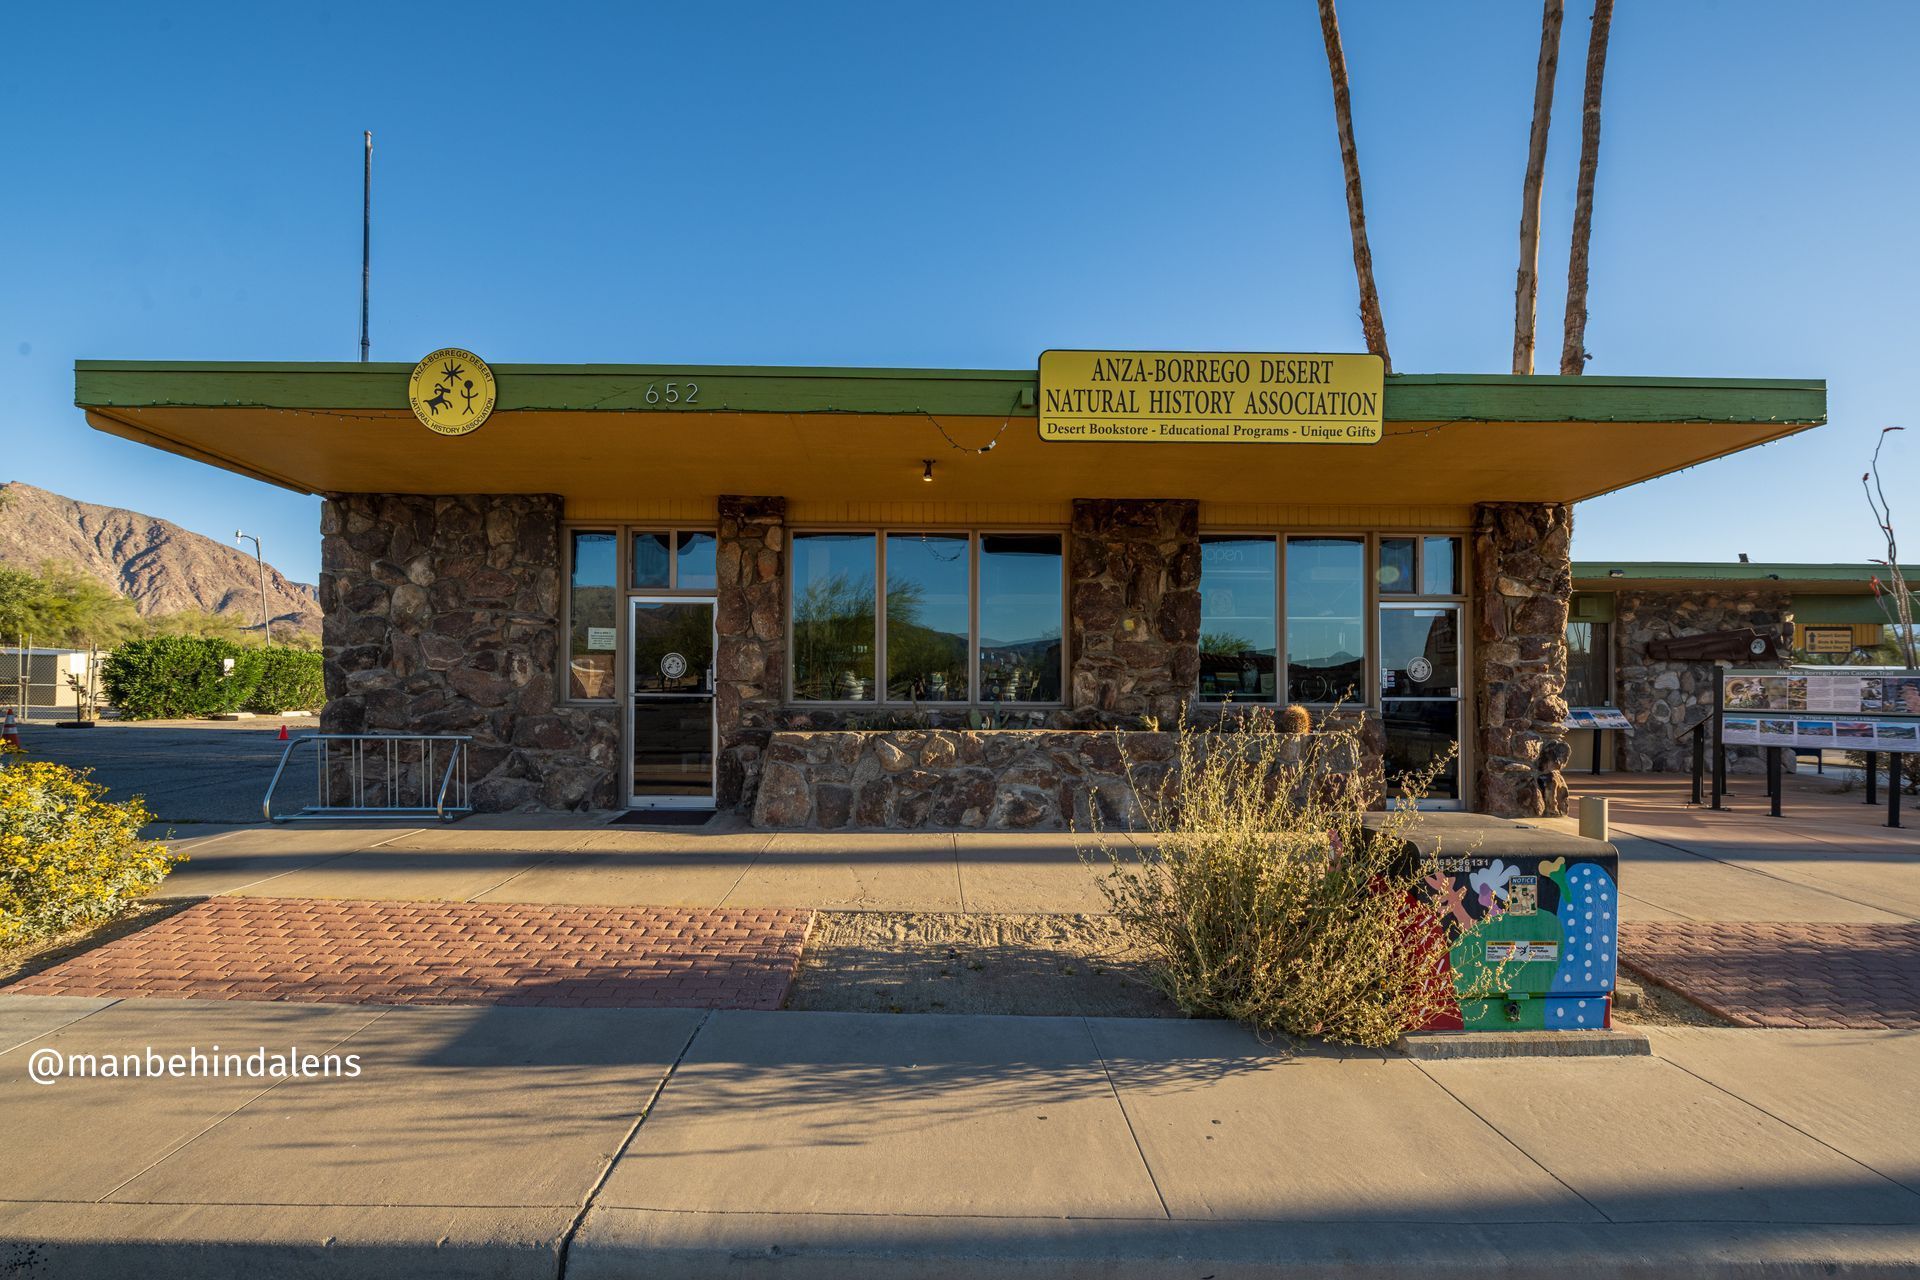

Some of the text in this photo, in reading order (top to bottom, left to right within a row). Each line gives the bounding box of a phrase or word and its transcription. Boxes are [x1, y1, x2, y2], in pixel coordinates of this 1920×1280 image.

[413, 350, 493, 383] ANZA-BORREGO DESERT
[1091, 358, 1334, 384] ANZA-BORREGO DESERT
[646, 383, 698, 404] 652
[1046, 389, 1377, 416] NATURAL HISTORY ASSOCIATION
[411, 397, 493, 434] NATURAL HISTORY ASSOCIATION
[1047, 423, 1086, 434] Desert
[1089, 423, 1149, 435] Bookstore
[1159, 424, 1230, 436] Educational
[1233, 425, 1289, 438] Programs
[1301, 426, 1343, 439] Unique
[1346, 426, 1376, 437] Gifts
